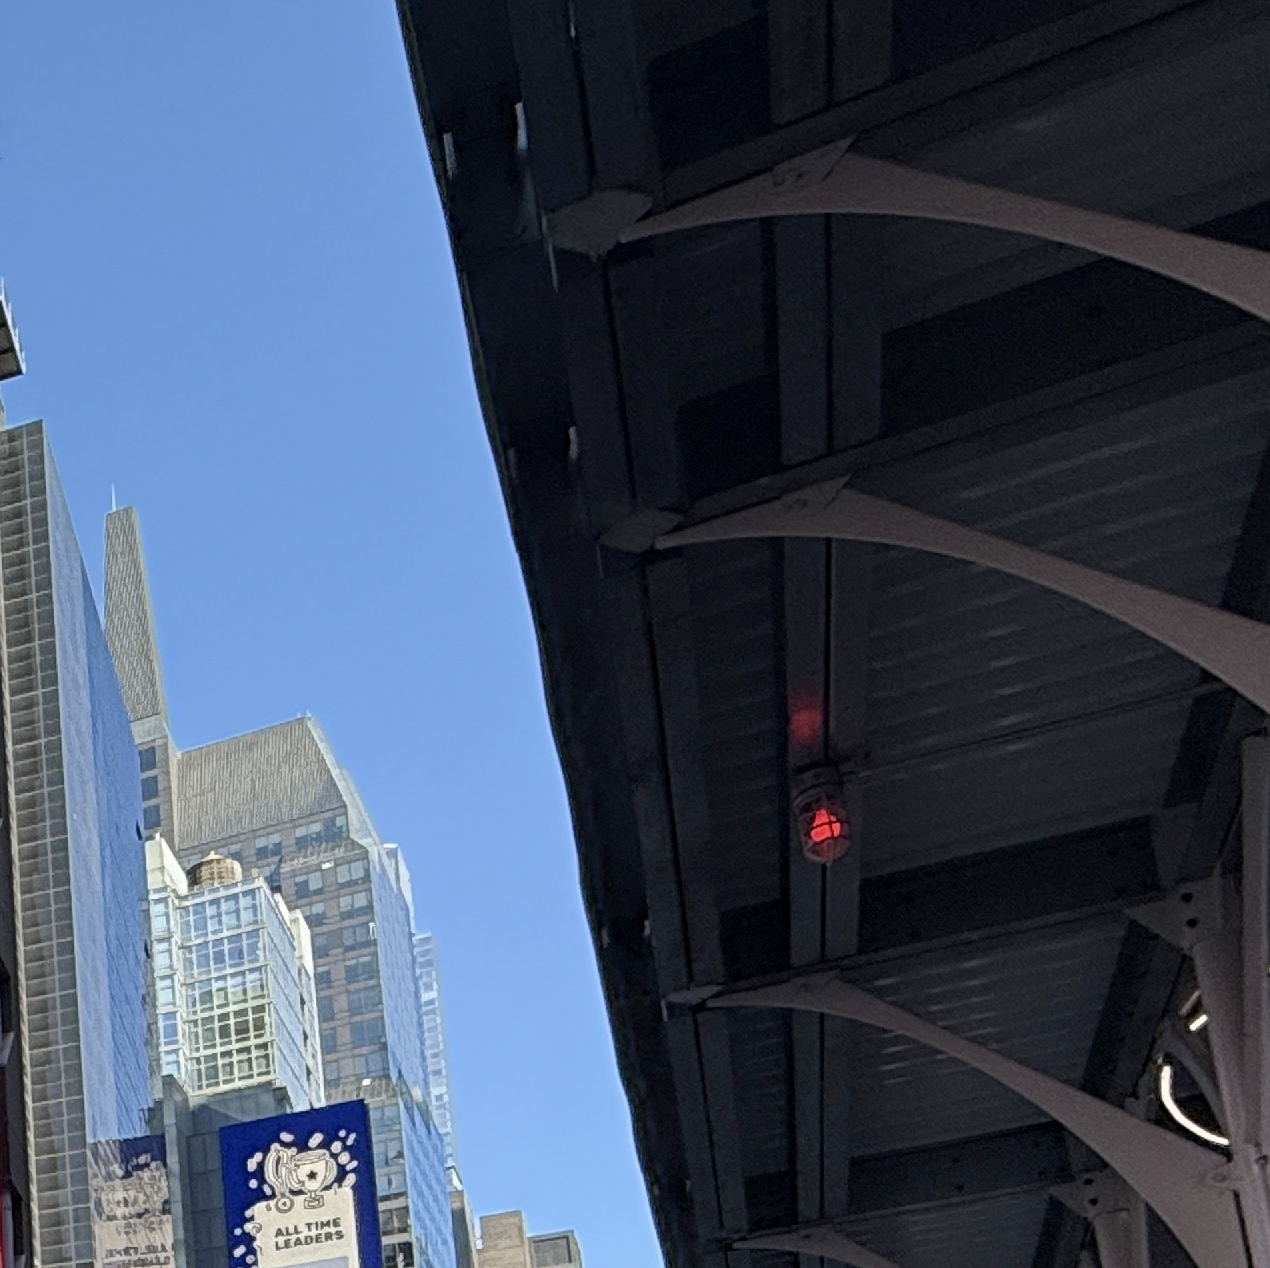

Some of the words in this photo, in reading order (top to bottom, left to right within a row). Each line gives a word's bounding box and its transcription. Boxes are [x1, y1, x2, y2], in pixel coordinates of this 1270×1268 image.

[274, 1224, 303, 1238] ALL
[304, 1217, 342, 1233] TIME
[275, 1230, 345, 1251] LEADERS
